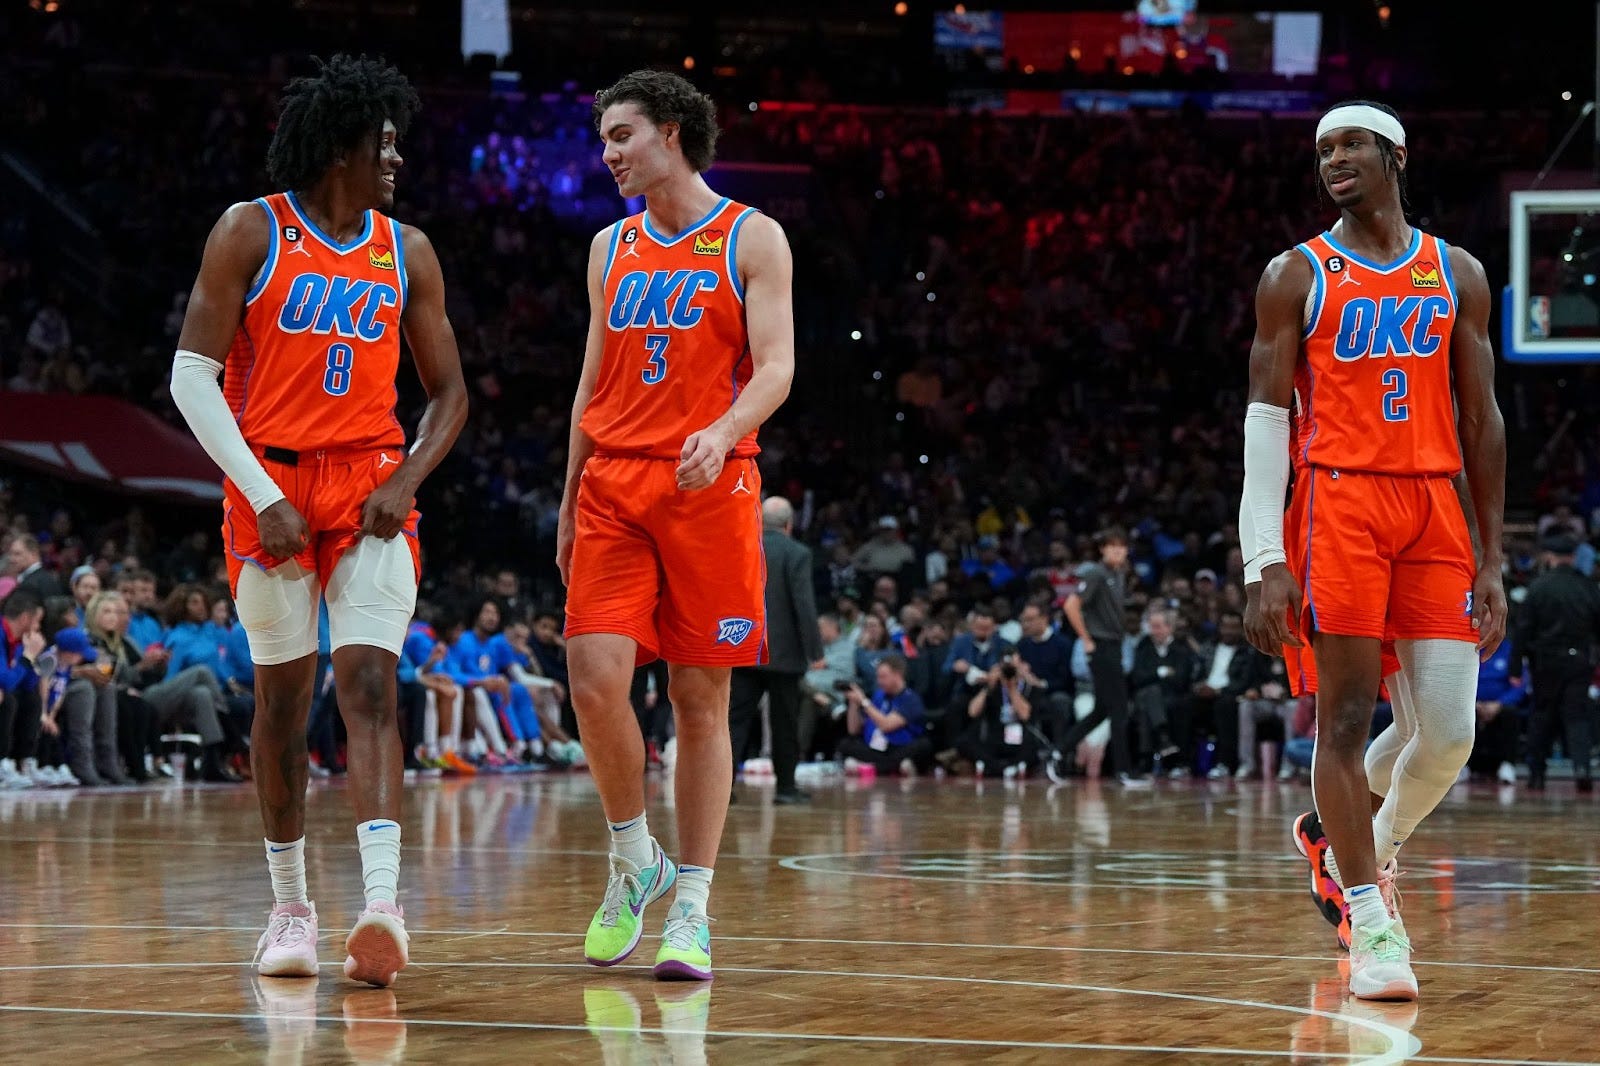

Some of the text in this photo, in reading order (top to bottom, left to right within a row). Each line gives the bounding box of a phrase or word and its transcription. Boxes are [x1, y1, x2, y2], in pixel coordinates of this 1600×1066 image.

[285, 228, 297, 241] 6
[625, 228, 637, 242] 6
[1329, 257, 1342, 271] 6
[277, 272, 398, 343] OKC
[607, 269, 720, 332] OKC
[1333, 294, 1450, 362] OKC
[322, 342, 354, 397] 8
[641, 333, 670, 385] 3
[1381, 368, 1409, 422] 2
